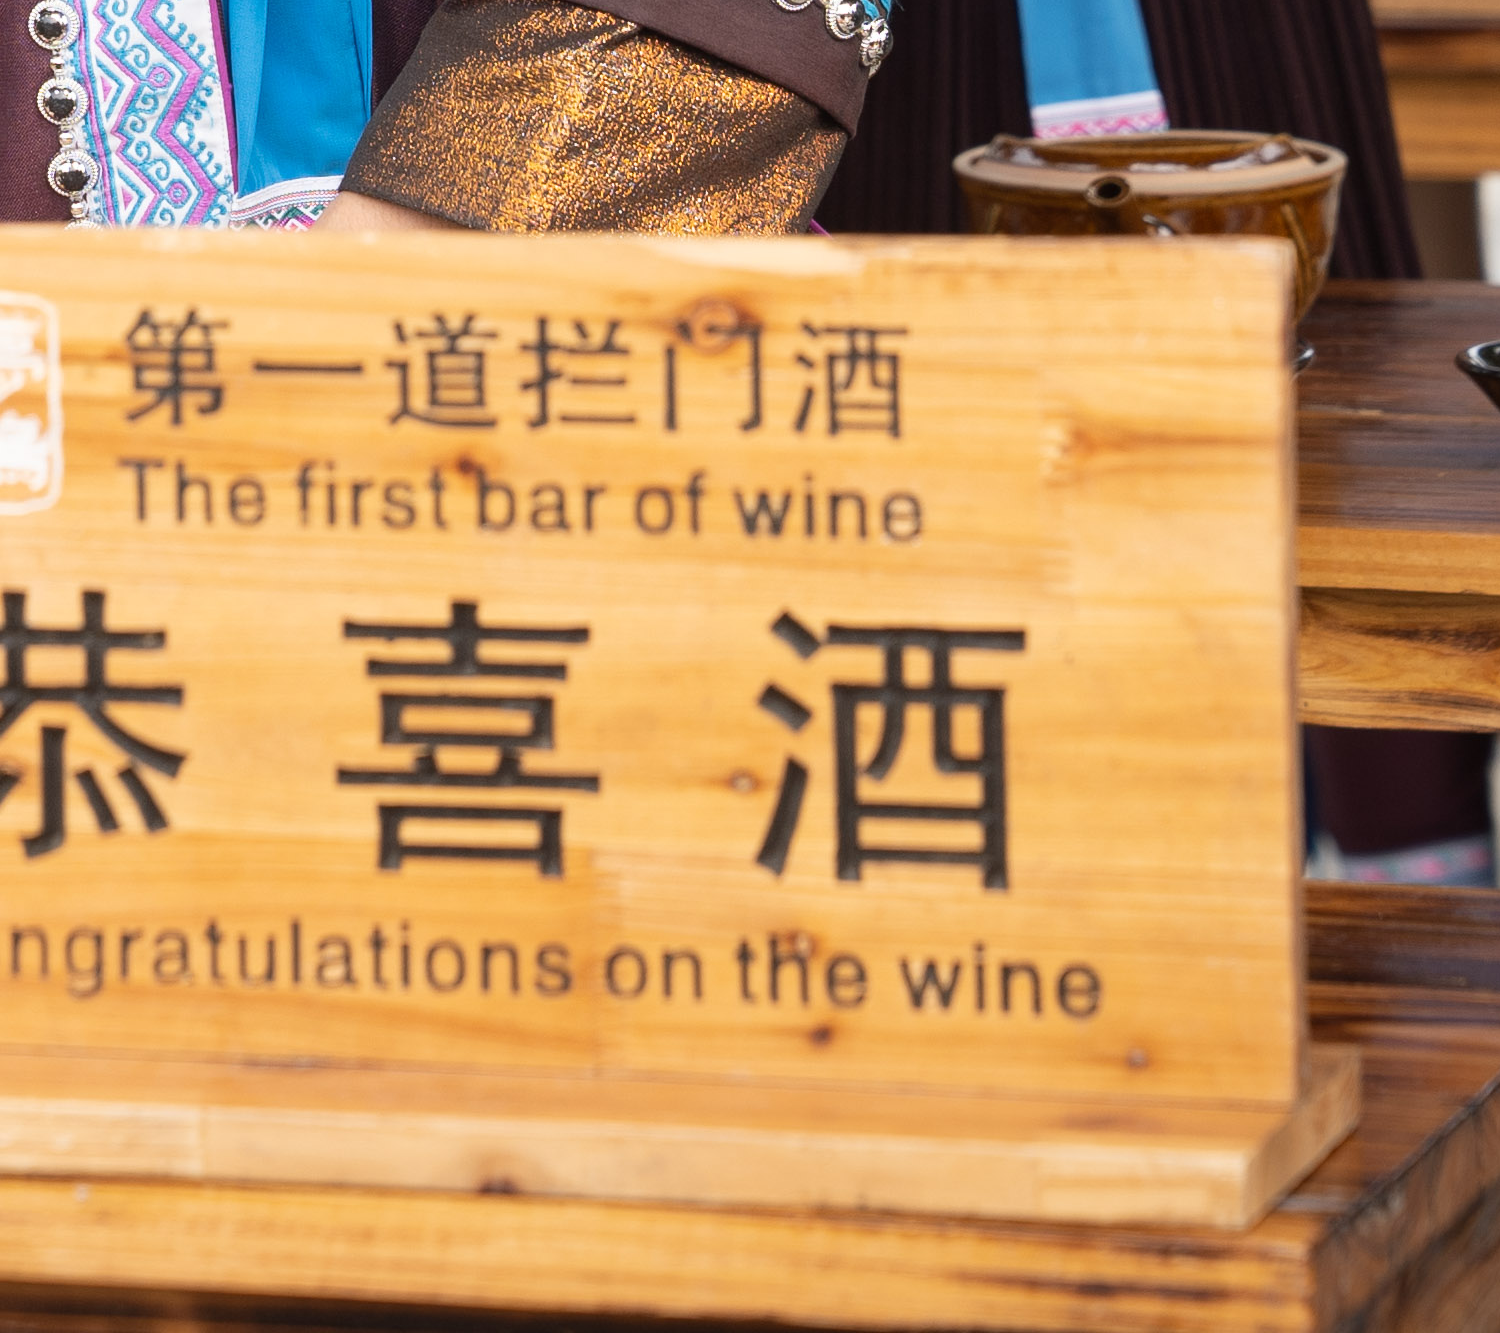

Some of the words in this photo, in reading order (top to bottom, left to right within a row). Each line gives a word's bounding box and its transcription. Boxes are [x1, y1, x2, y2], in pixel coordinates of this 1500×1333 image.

[121, 300, 909, 440] 第一道拦门酒
[117, 454, 268, 526] The
[292, 456, 448, 530] first
[475, 460, 607, 535] bar
[632, 470, 707, 537] of
[732, 471, 924, 545] wine
[601, 943, 705, 1001] on
[733, 930, 870, 1010] the
[897, 941, 1104, 1020] wine
